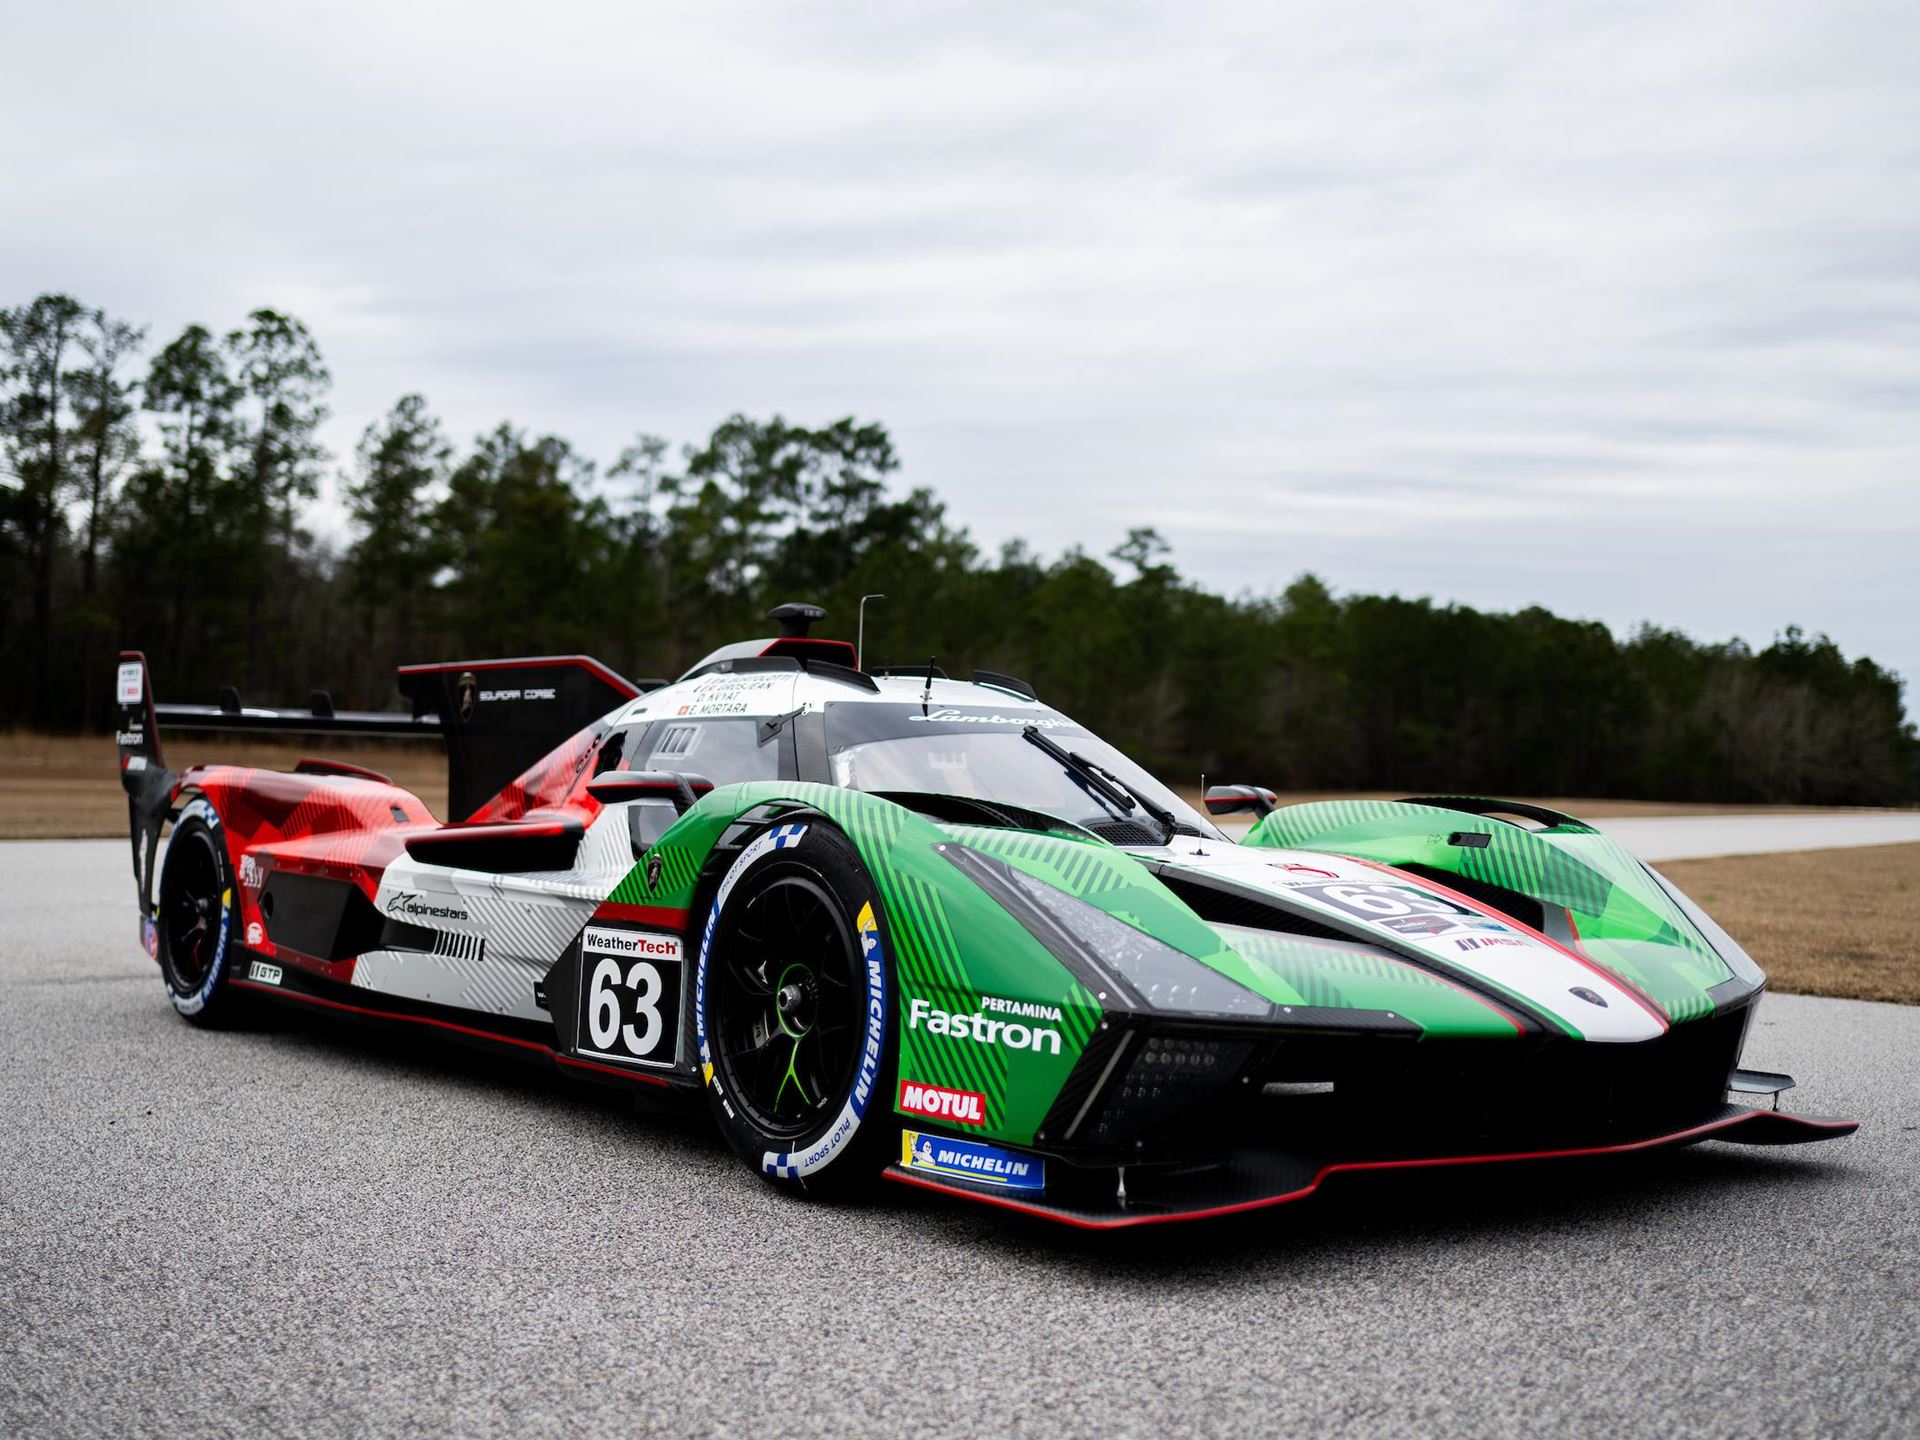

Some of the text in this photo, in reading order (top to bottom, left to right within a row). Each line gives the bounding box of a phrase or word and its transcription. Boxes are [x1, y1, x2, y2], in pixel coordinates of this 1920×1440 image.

[524, 688, 556, 700] CORSE
[708, 690, 742, 701] KVYAT
[700, 703, 748, 714] MORTARA
[909, 709, 1080, 728] Lamborghi
[407, 903, 468, 920] alpinestars
[1322, 885, 1458, 914] 63
[202, 923, 228, 998] MICHELIN
[259, 967, 281, 980] GTP
[695, 906, 716, 1037] MICHELIN
[588, 957, 663, 1056] 63
[981, 996, 1063, 1022] PERTAMINA
[855, 960, 883, 1105] MICHELIN
[909, 998, 1062, 1055] Fastron
[902, 1085, 982, 1121] MOTUL
[804, 1116, 851, 1168] PILOT SPORT
[937, 1149, 1030, 1176] MICHELIN
